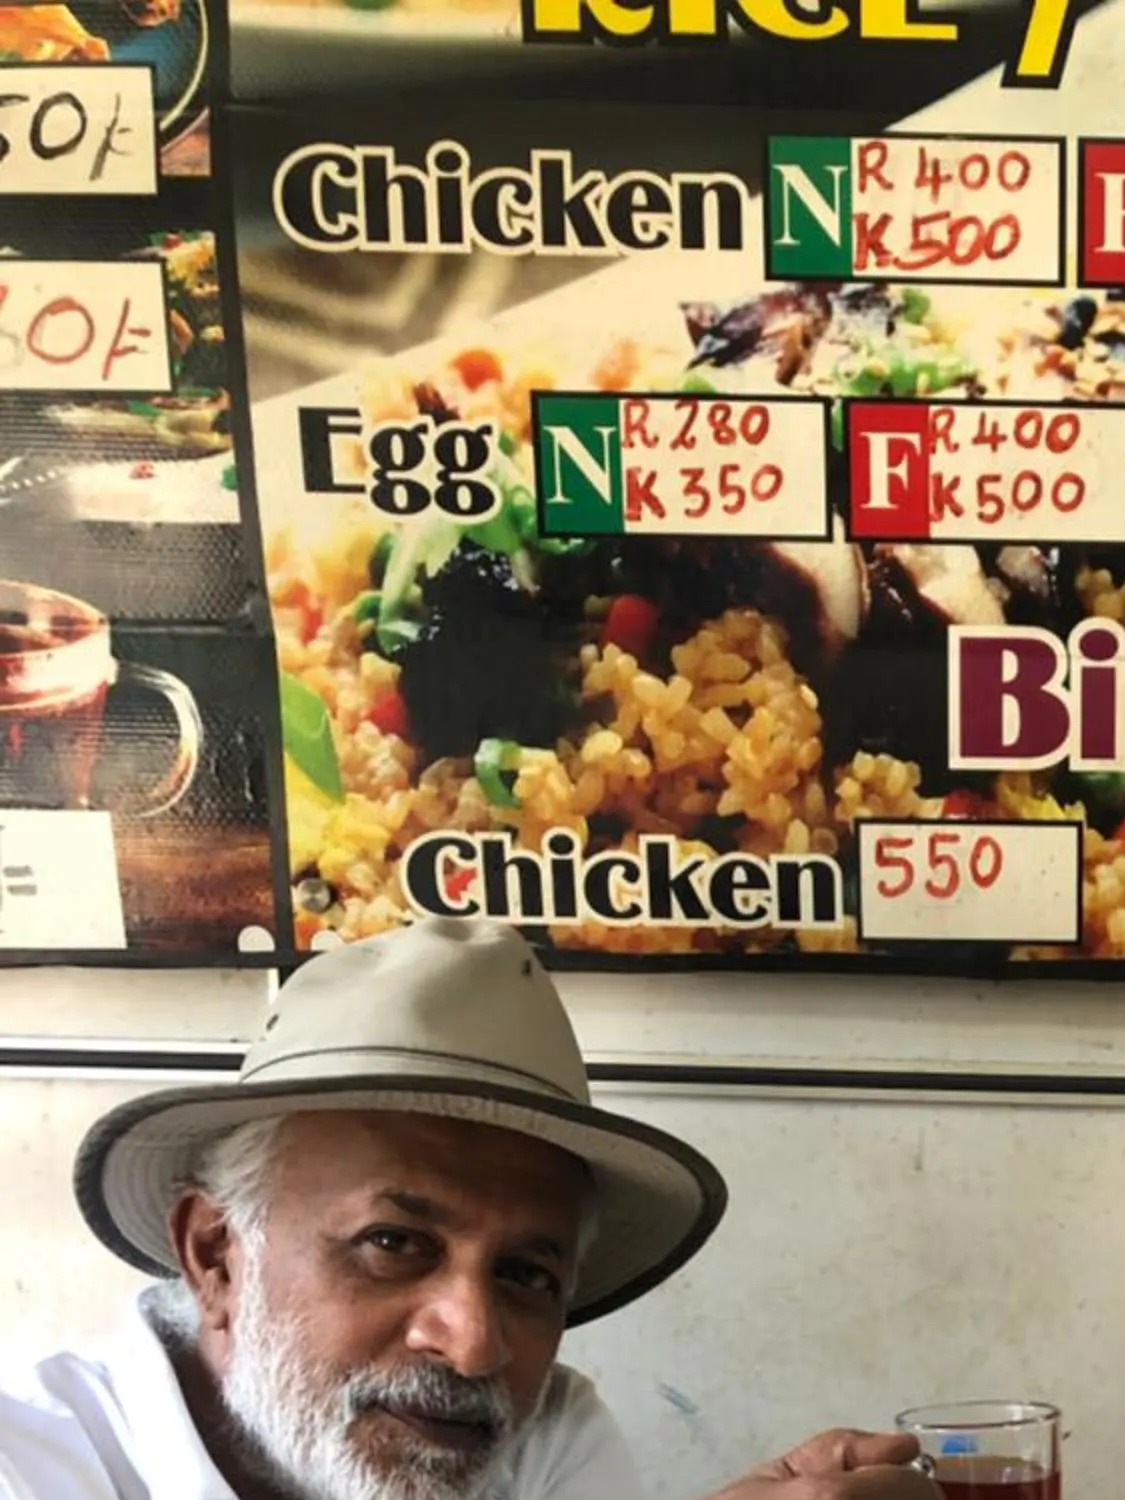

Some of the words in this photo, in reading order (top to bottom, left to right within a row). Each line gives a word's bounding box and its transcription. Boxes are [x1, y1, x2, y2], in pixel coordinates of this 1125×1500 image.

[277, 140, 746, 252] Chicken
[773, 163, 849, 249] N
[297, 406, 497, 516] Egg
[544, 424, 617, 505] N
[860, 431, 921, 510] F
[405, 830, 838, 923] Chicken
[873, 832, 1004, 899] 550
